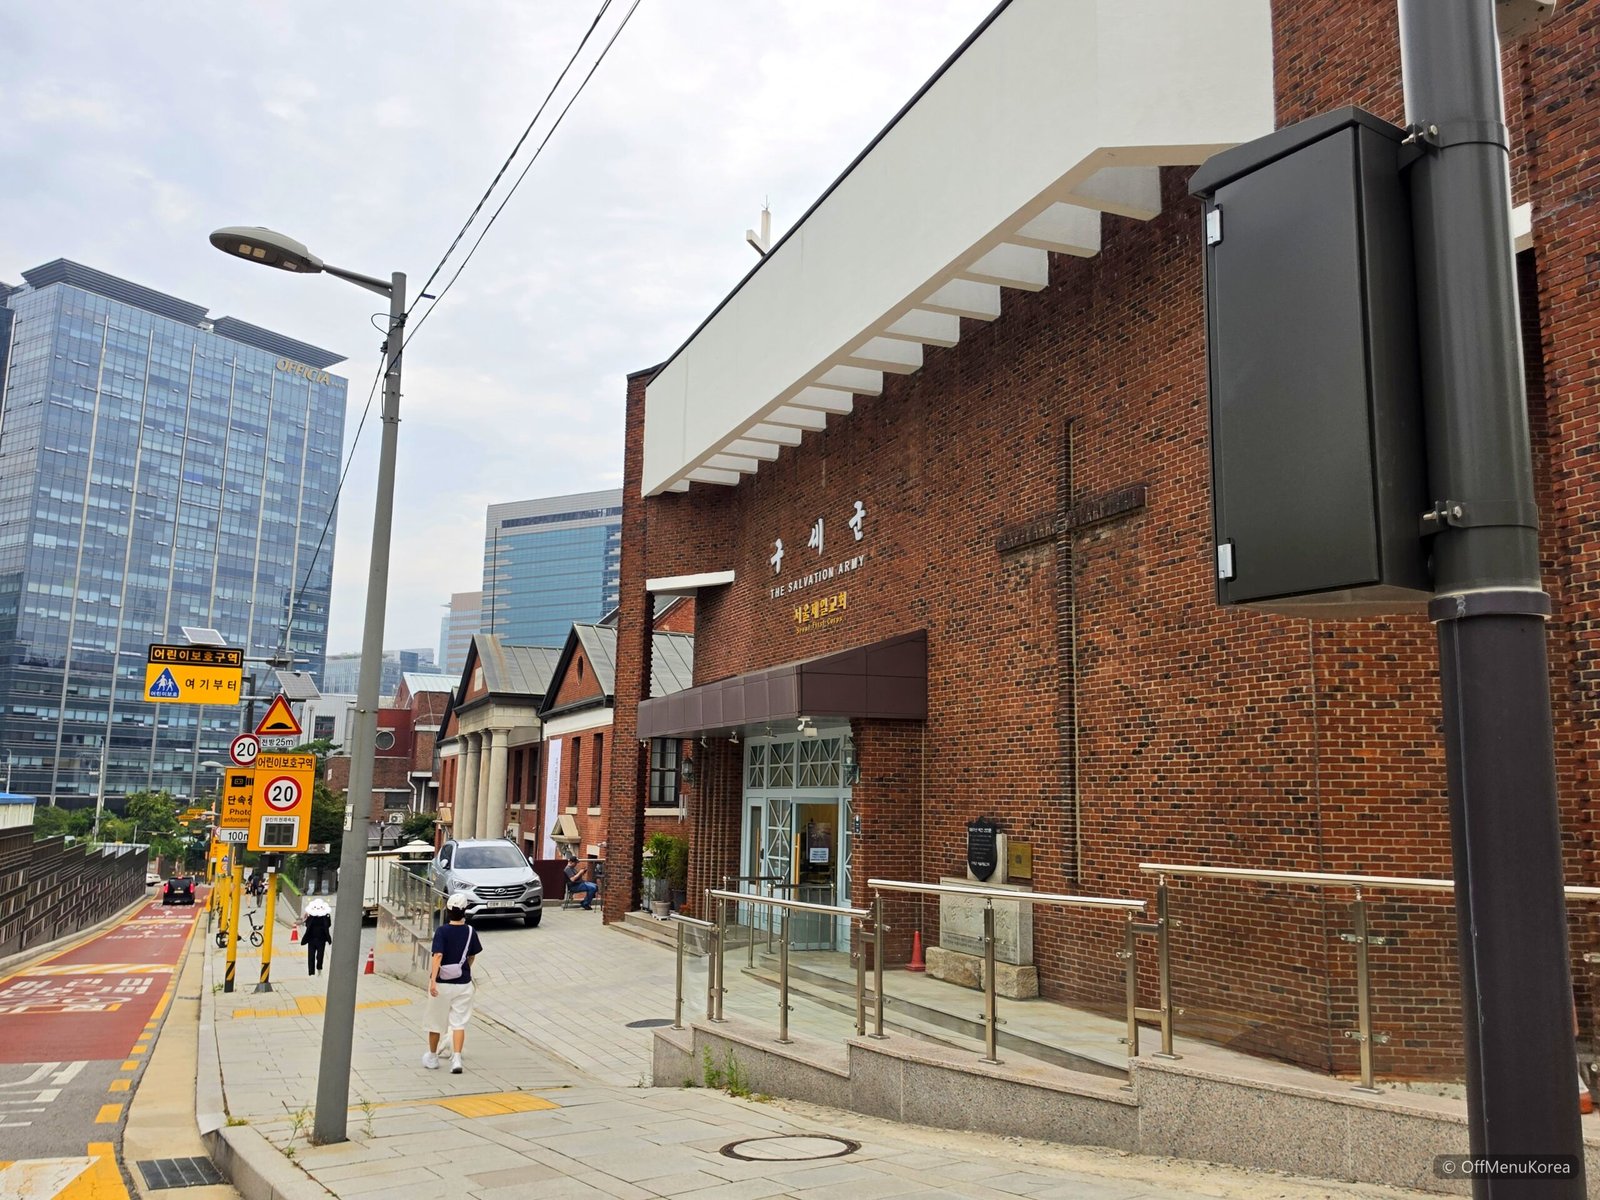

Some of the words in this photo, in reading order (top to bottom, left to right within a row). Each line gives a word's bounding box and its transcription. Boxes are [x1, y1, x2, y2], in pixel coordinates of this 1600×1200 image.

[770, 500, 867, 574] 구세군
[770, 585, 785, 599] THE
[787, 566, 834, 593] SALVATION
[838, 554, 865, 575] ARMY
[793, 591, 847, 623] 서울제일교회
[827, 616, 843, 626] Corps
[153, 649, 238, 664] 어린이보호구역
[185, 678, 237, 691] 여기부터
[236, 742, 256, 757] 20
[257, 756, 313, 769] 어린이보호구역
[272, 785, 293, 802] 20
